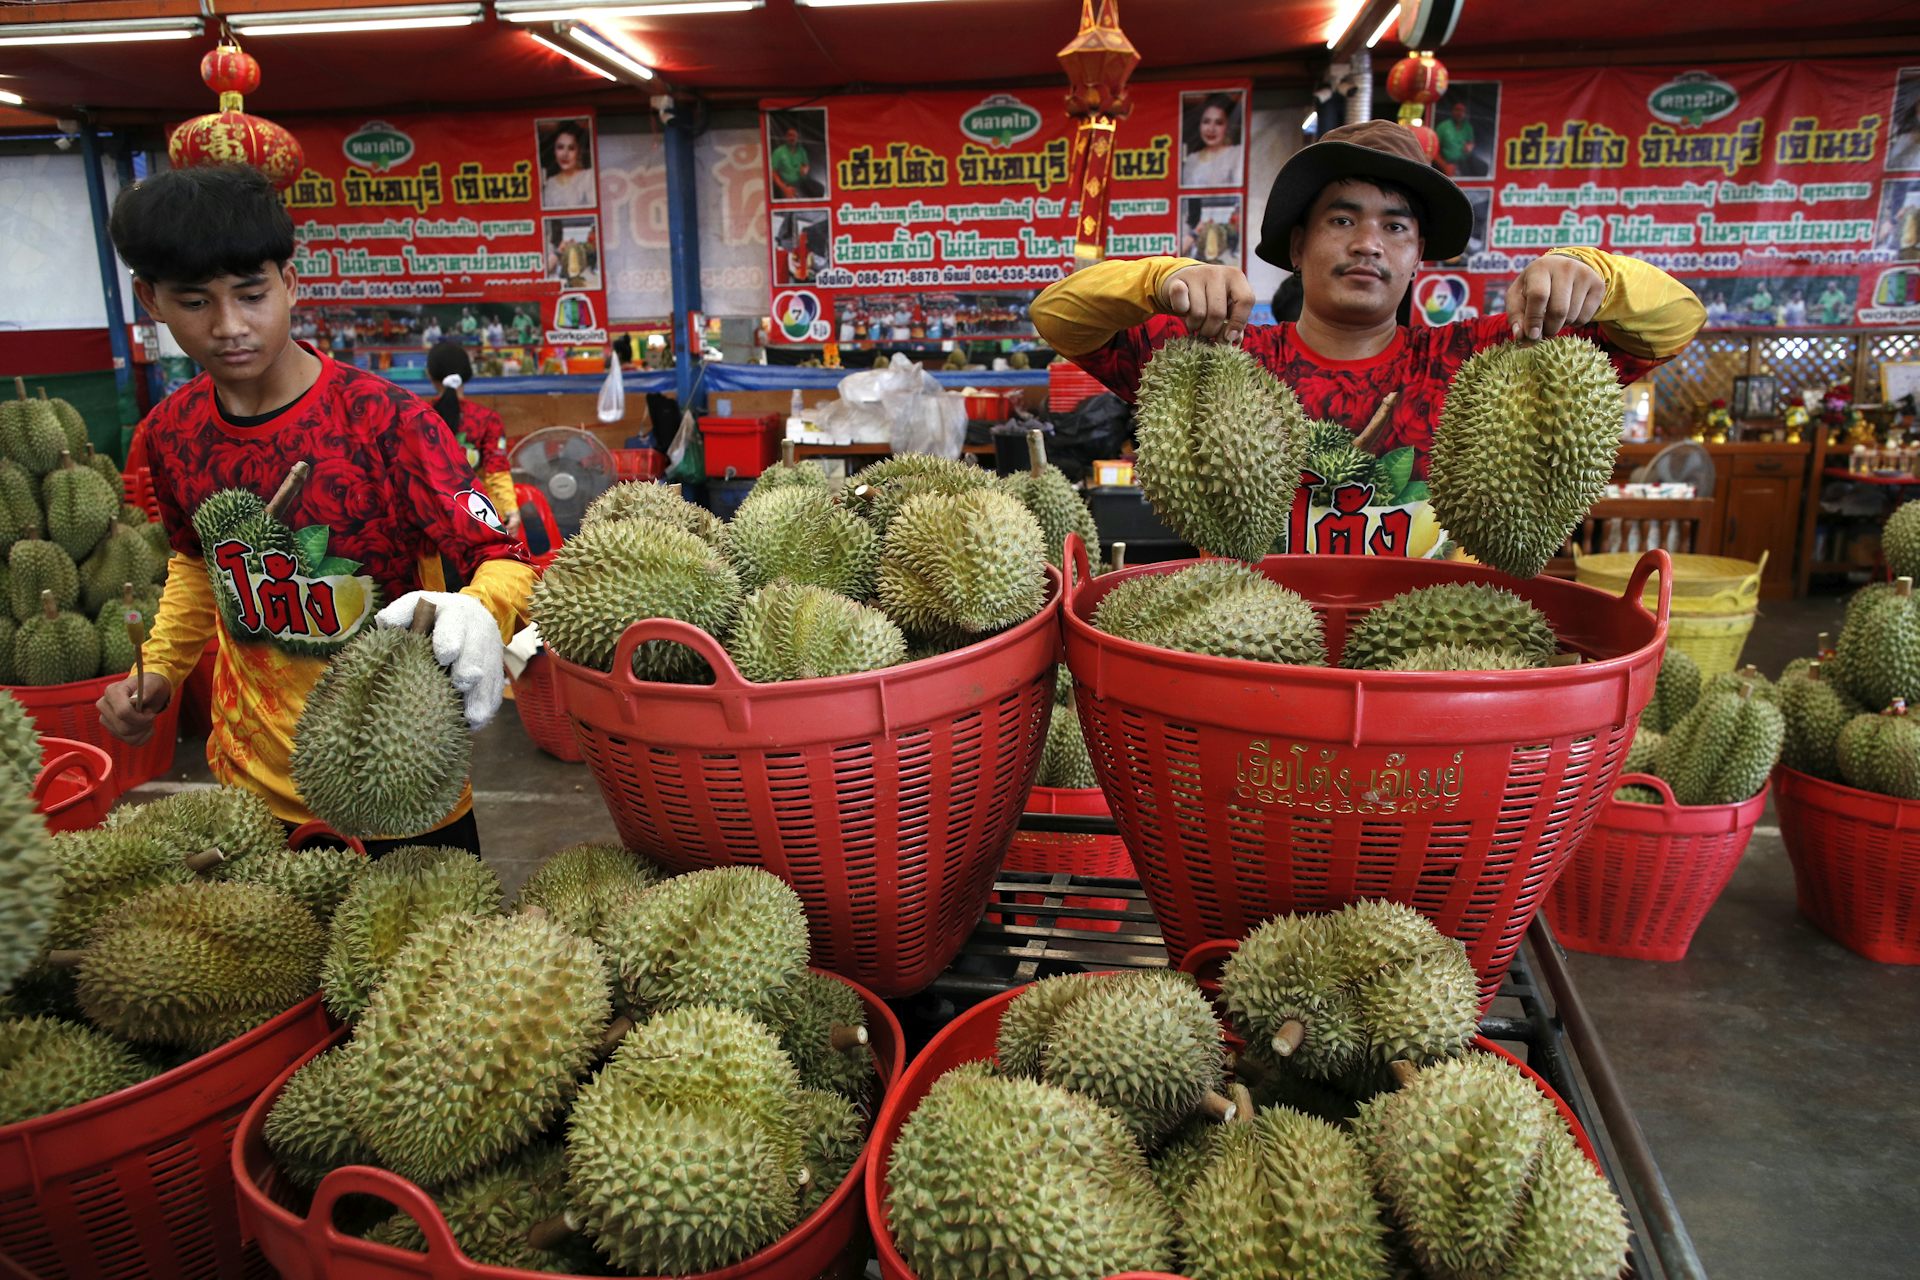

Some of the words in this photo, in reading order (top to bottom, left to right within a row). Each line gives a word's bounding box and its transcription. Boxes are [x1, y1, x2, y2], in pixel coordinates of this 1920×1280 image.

[970, 112, 1032, 131] ตลาดไท
[1639, 116, 1764, 175] จันทบุรี
[838, 142, 948, 188] เฮียโต้ง
[957, 137, 1067, 192] จันทบุรี
[344, 163, 443, 213] จันทบุรี
[1607, 215, 1694, 245] ไม่มีขาด
[834, 228, 934, 264] มีของทั้งปี
[938, 230, 1019, 260] ไม่มีขาด
[334, 248, 405, 275] ไม่มีขาด
[856, 269, 940, 284] 086-271-8878
[974, 265, 1060, 281] 084-636-5496
[791, 308, 802, 321] 7
[547, 330, 606, 342] workpoint
[214, 539, 341, 637] โต้ง
